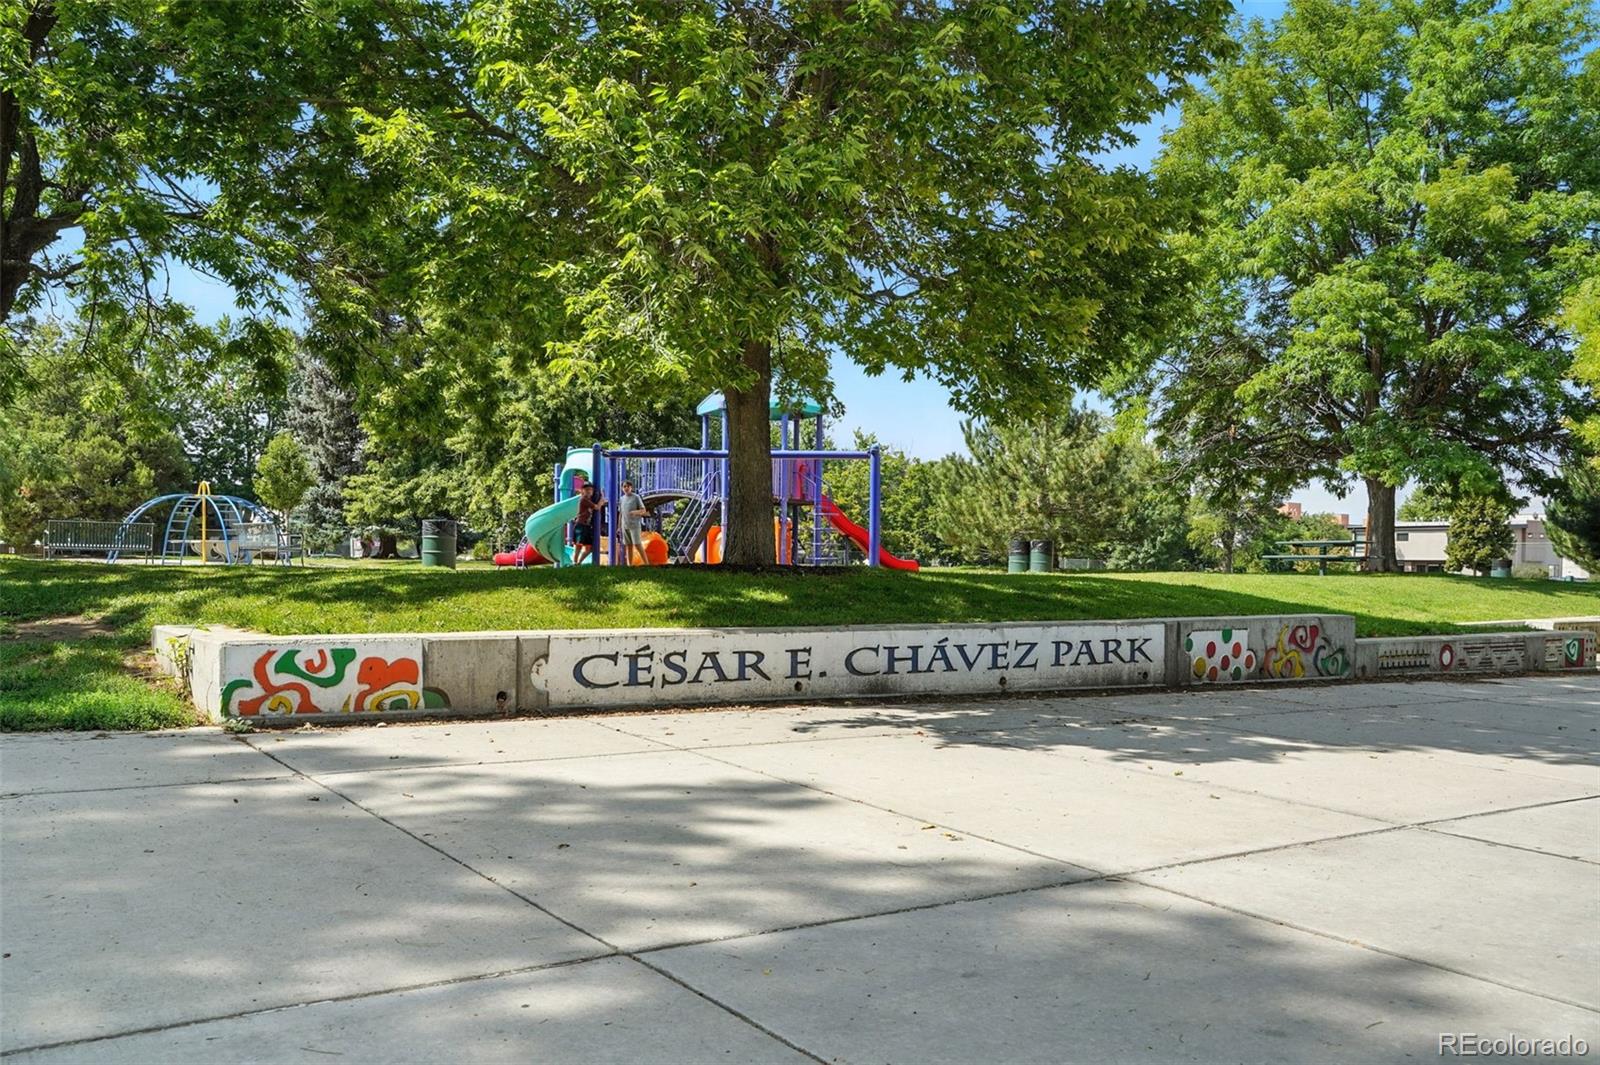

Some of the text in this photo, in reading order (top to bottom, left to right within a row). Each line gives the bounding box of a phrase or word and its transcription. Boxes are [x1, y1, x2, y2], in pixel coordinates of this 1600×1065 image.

[573, 636, 1153, 689] CÉSAR E. CHÁVEZ PARK
